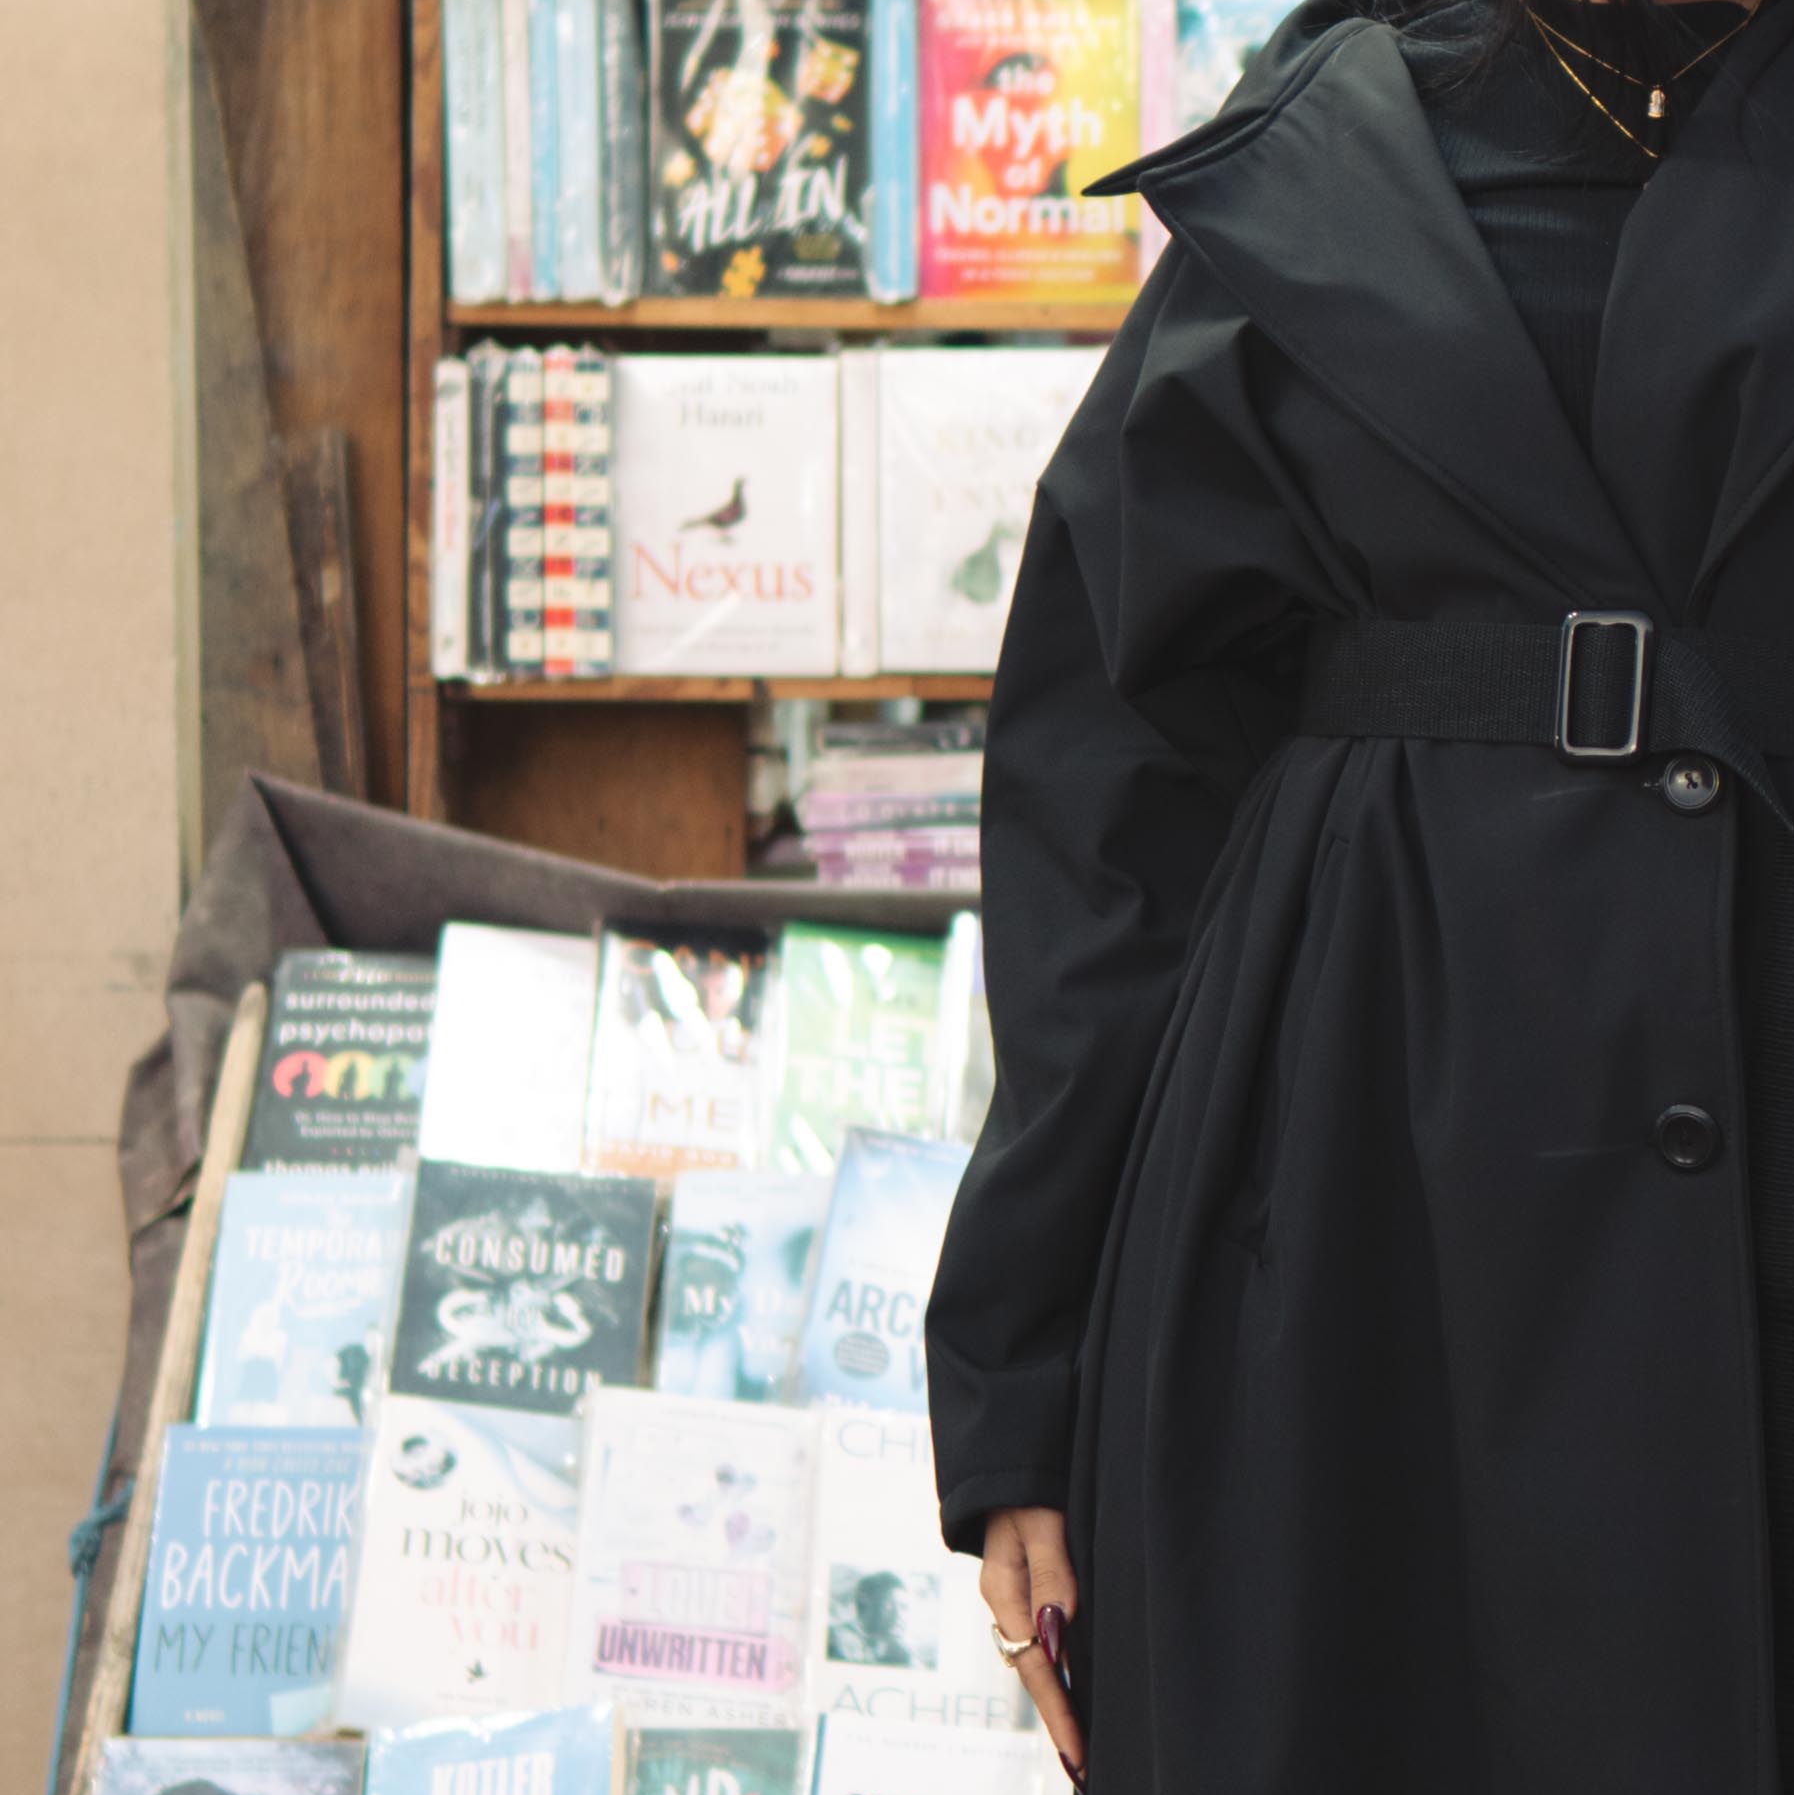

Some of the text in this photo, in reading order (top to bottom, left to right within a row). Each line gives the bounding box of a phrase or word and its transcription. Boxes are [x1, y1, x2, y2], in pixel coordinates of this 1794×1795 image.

[997, 66, 1057, 95] the
[952, 97, 1103, 159] Myth
[777, 154, 847, 237] IN
[1004, 163, 1041, 189] of
[929, 182, 1126, 236] Normal
[629, 540, 816, 603] Nexus
[285, 990, 438, 1011] surrounded
[278, 1017, 430, 1047] psychopa
[651, 1091, 739, 1132] ME
[246, 1226, 388, 1263] TEMPORA
[436, 1231, 626, 1283] CONSUMED
[684, 1286, 733, 1326] My
[426, 1356, 601, 1397] DECEPTION
[203, 1479, 360, 1540] FREDRIK
[459, 1492, 529, 1527] jojo
[161, 1541, 348, 1611] BACKMA
[153, 1620, 335, 1677] MY FRIEN
[595, 1622, 769, 1683] UNWRITTEN
